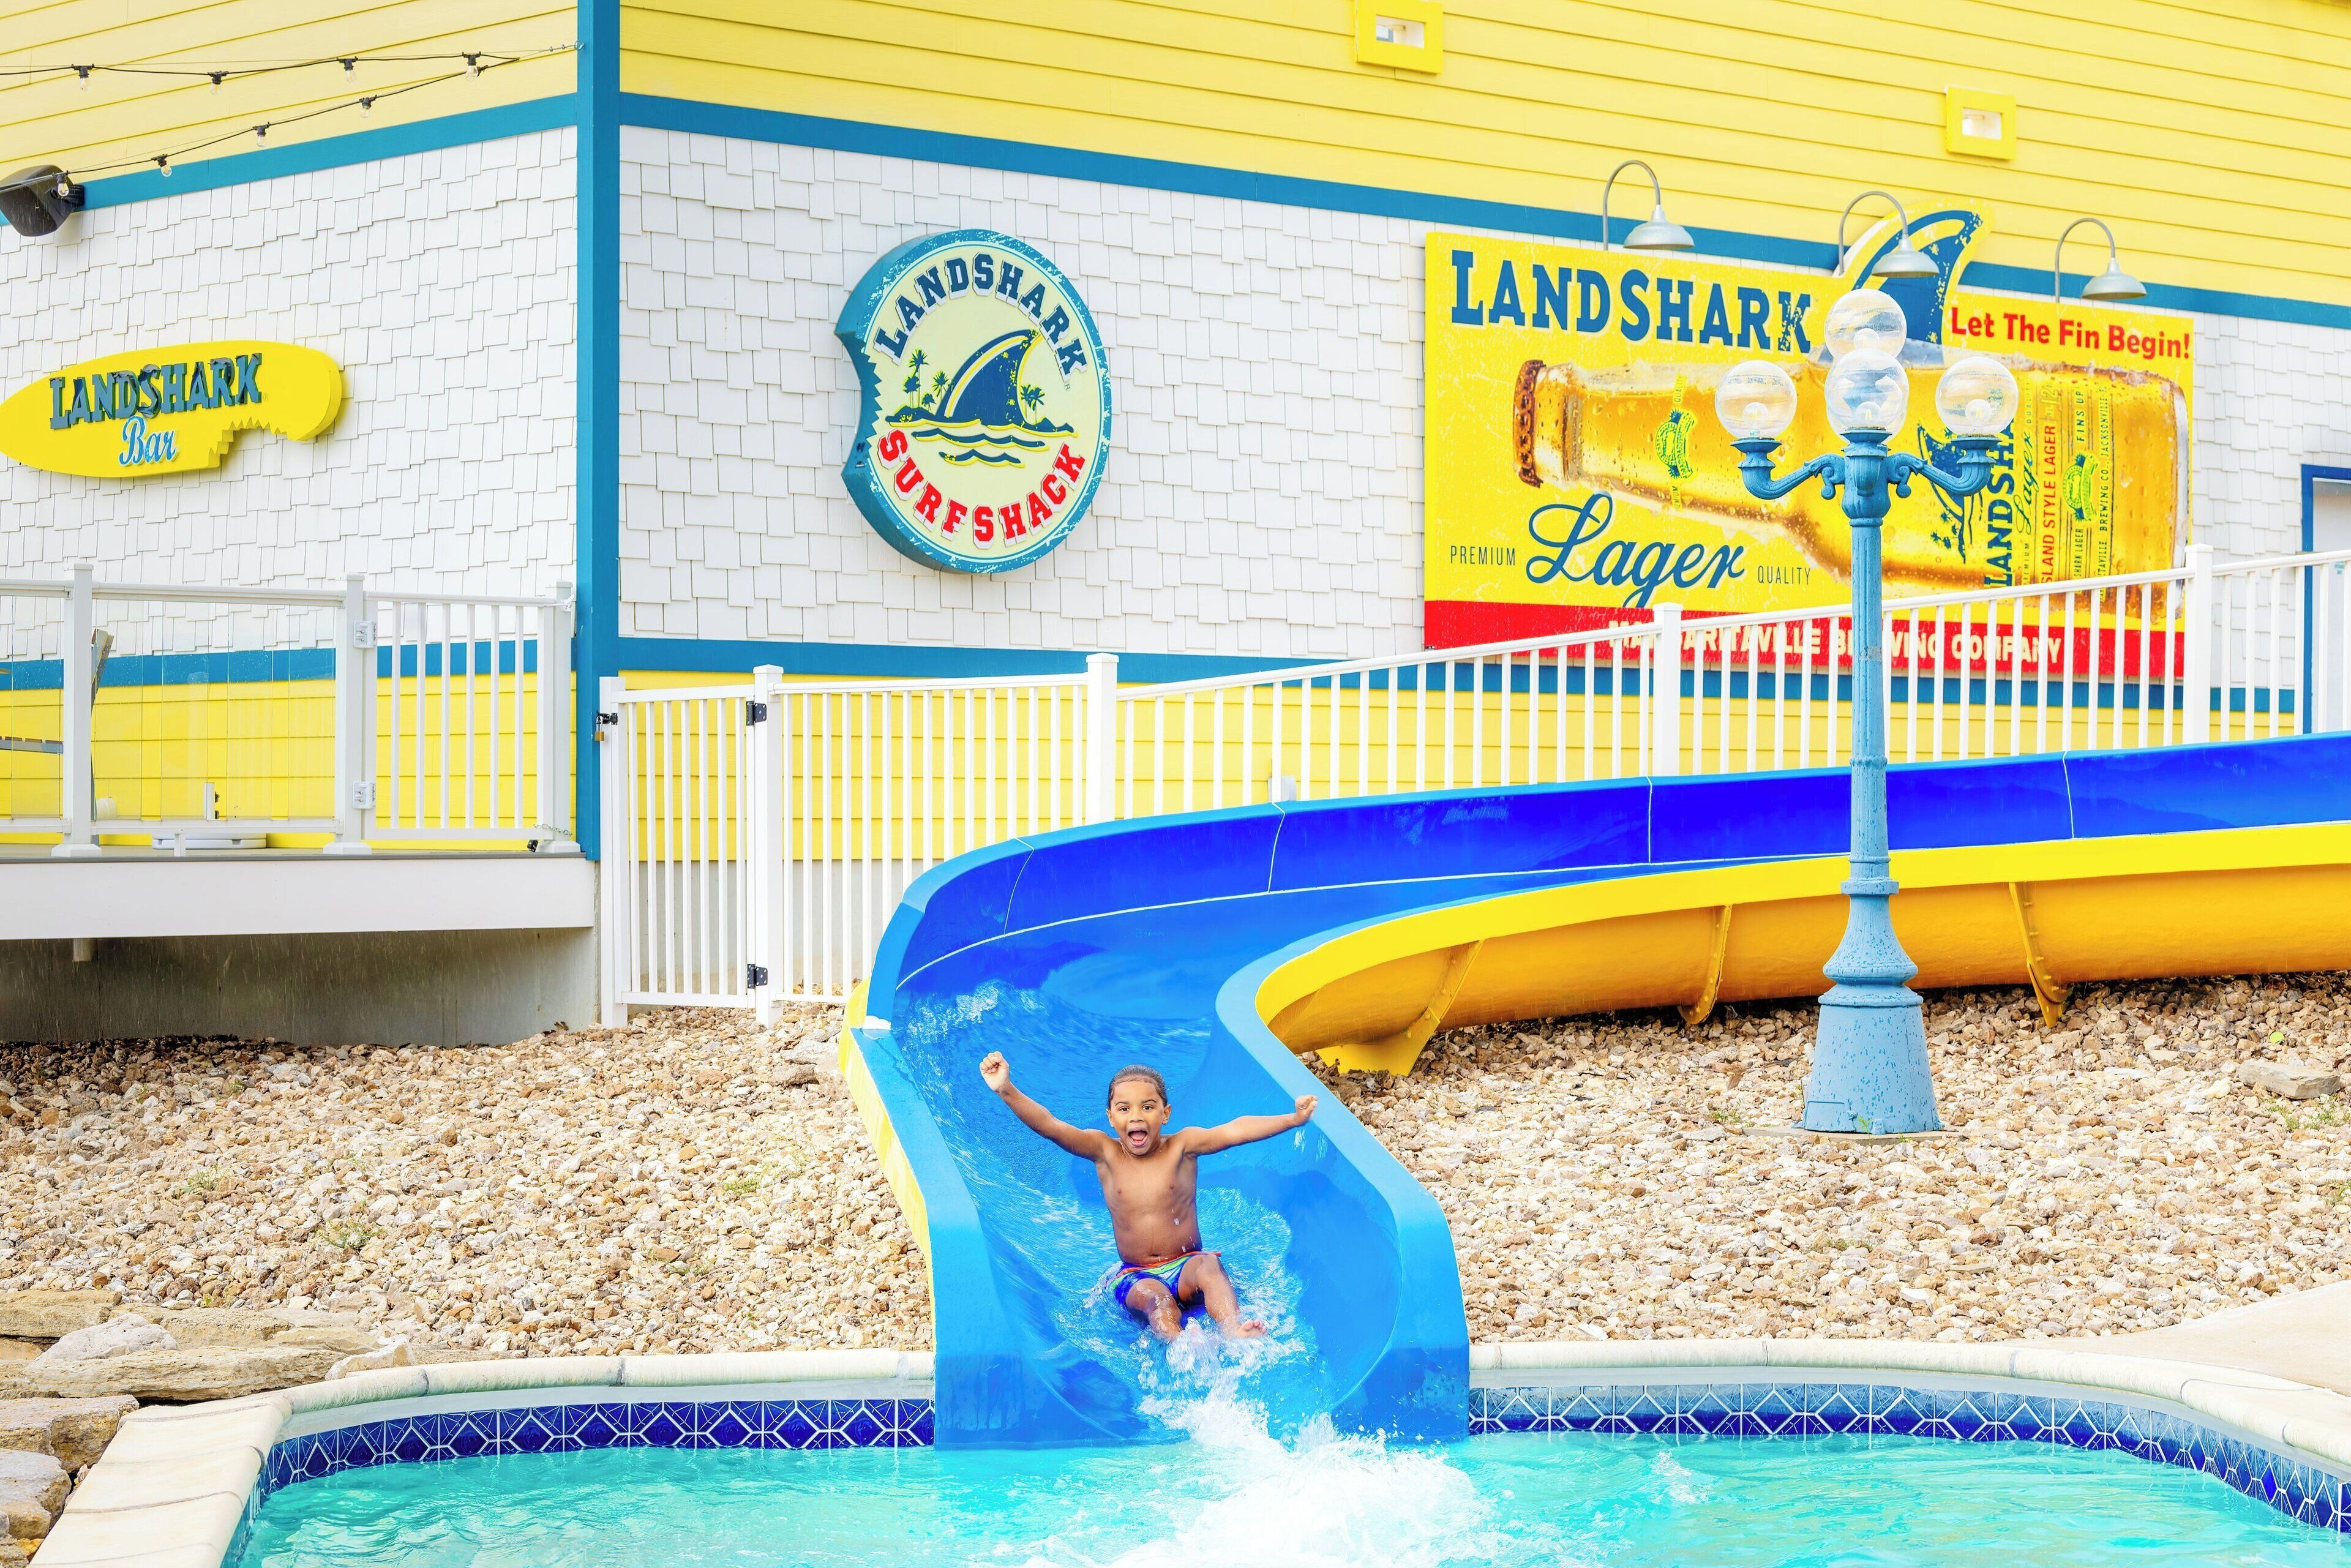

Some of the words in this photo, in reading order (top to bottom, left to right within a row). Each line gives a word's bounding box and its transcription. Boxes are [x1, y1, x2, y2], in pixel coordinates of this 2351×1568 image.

[874, 253, 1087, 381] LANDSHARK
[1452, 249, 1811, 353] LANDSHARK
[1951, 307, 1995, 339] Let
[2004, 313, 2050, 345] The
[2060, 320, 2099, 350] Fin
[2108, 324, 2191, 360] Begin!
[49, 353, 263, 430] LANDSHARK
[119, 415, 178, 466] Bar
[2044, 426, 2056, 475] LAGER
[2076, 410, 2085, 441] FINS
[1984, 418, 2015, 587] LANDSH
[2013, 431, 2040, 535] Lager
[2043, 481, 2056, 528] STYLE
[2100, 486, 2109, 531] BREWING
[1450, 546, 1516, 566] PREMIUM
[1526, 491, 1745, 608] Lager
[1757, 565, 1810, 585] QUALITY
[2041, 535, 2056, 583] SLAND
[2075, 528, 2084, 552] LAGER
